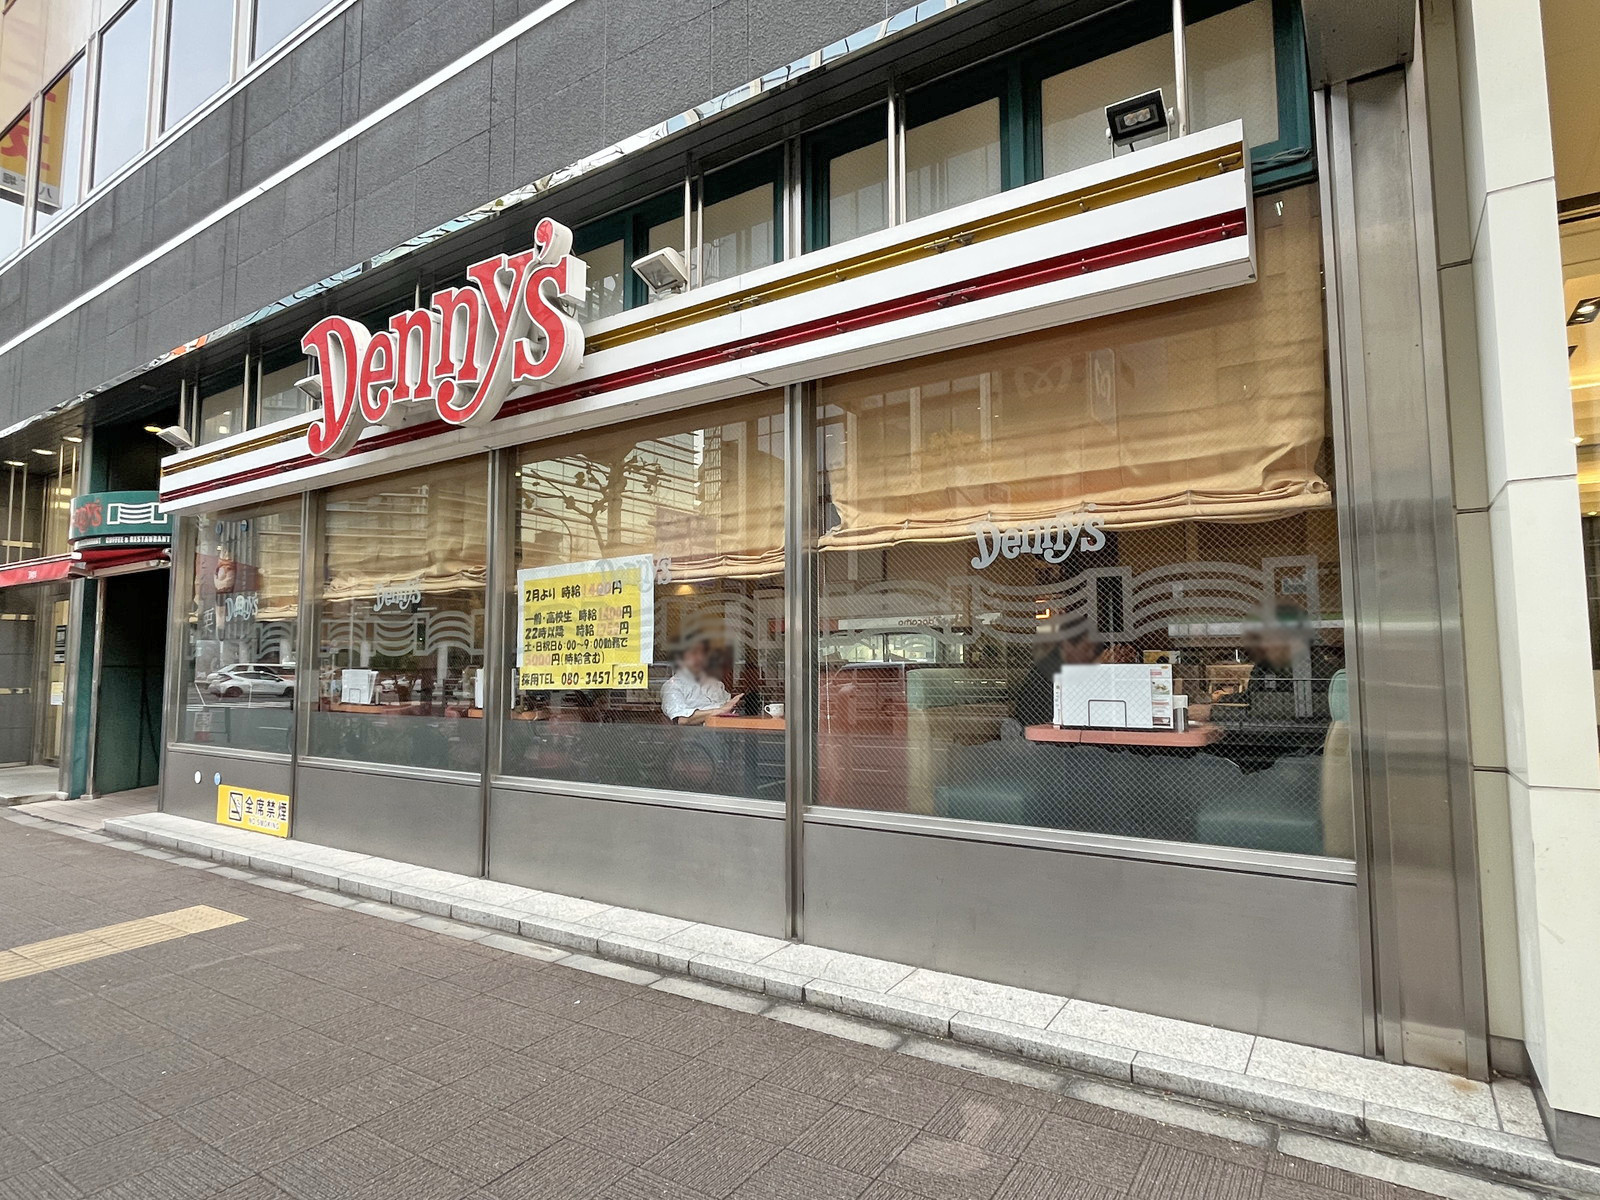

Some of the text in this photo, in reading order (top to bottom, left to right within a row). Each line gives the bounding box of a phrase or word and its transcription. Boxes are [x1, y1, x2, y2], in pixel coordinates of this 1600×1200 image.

[301, 217, 585, 457] Denny's
[130, 535, 170, 543] RESTAURANT
[971, 503, 1106, 569] Denny's
[525, 587, 555, 602] 2月より
[524, 625, 565, 640] 22時以降
[521, 672, 555, 687] 採用TEL
[245, 796, 287, 821] 全席禁煙
[257, 818, 280, 830] SMOKING
